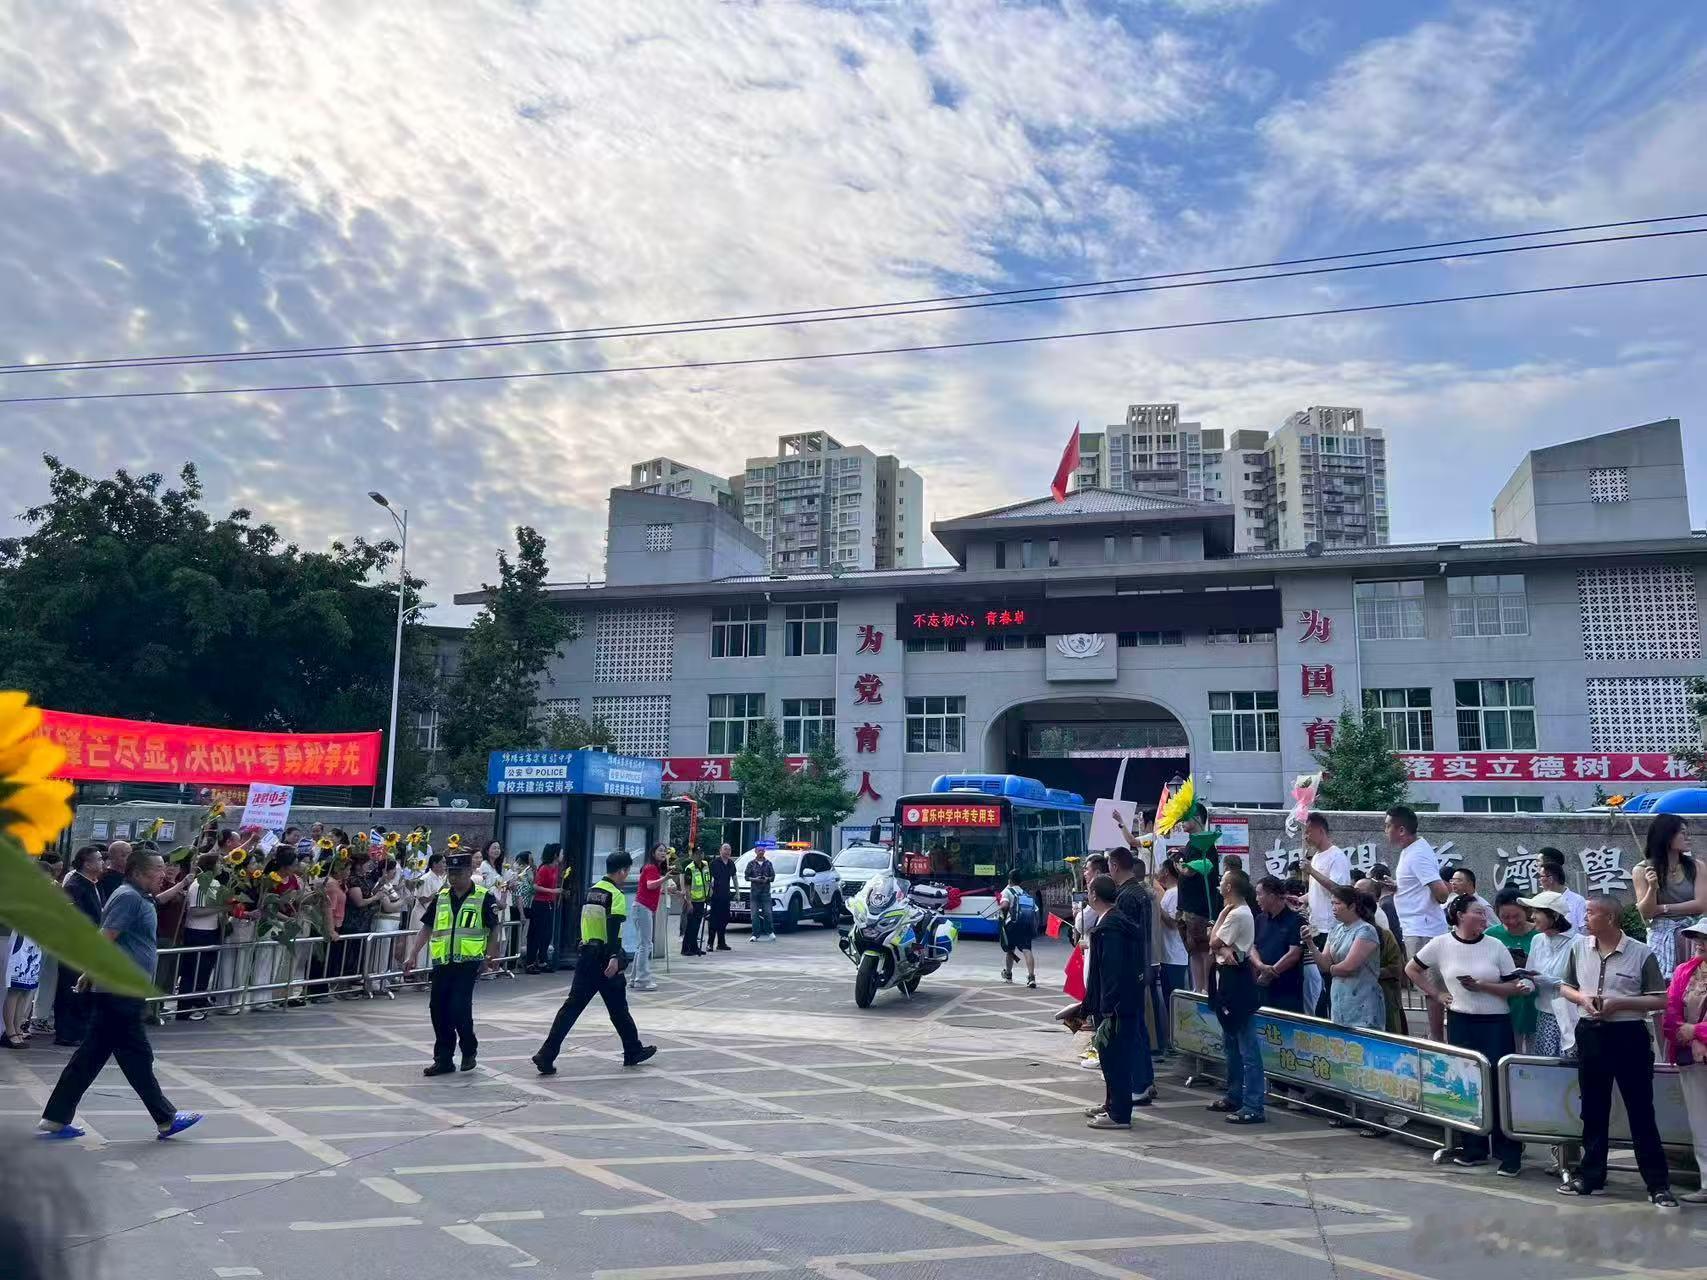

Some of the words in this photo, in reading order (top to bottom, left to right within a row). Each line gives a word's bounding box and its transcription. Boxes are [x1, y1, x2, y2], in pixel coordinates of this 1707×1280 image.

[853, 624, 884, 800] 为党育人
[508, 769, 522, 777] 公安
[535, 768, 564, 777] POLICE
[497, 780, 574, 793] 警校共建治安岗亭
[604, 782, 645, 797] 警校共建治安岗亭
[921, 808, 995, 823] 富乐中学中考专用车
